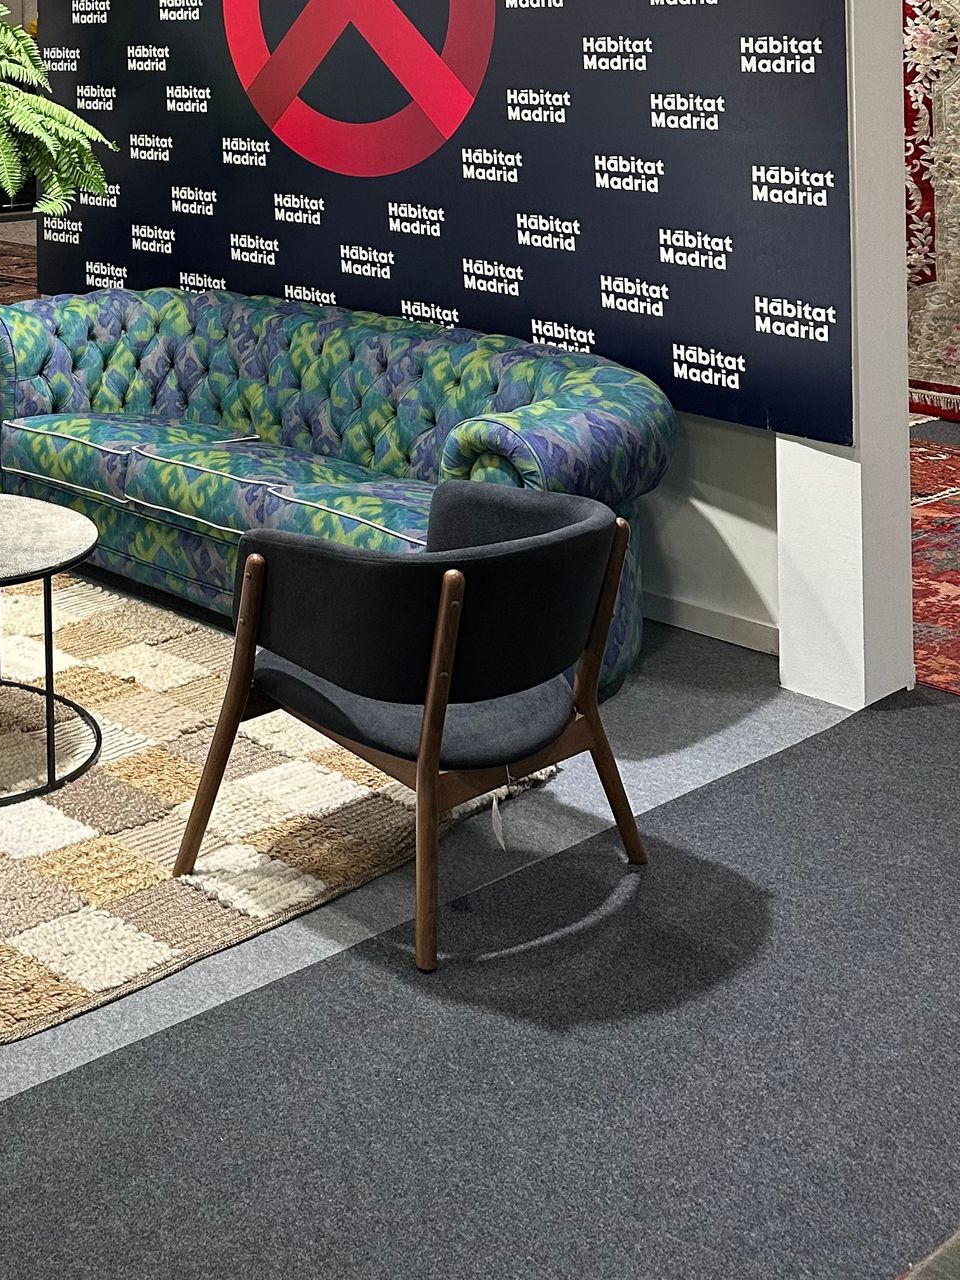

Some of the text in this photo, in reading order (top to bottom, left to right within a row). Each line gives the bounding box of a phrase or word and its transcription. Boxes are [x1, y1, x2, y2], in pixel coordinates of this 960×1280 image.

[72, 11, 107, 23] Madrid
[160, 7, 199, 20] Madrid
[128, 58, 166, 71] Madrid
[584, 54, 646, 71] Madrid
[741, 55, 815, 73] Madrid
[77, 98, 112, 110] Madrid
[167, 99, 207, 112] Madrid
[508, 106, 565, 123] Madrid
[651, 112, 718, 130] Madrid
[131, 147, 169, 161] Madrid
[223, 152, 266, 166] Madrid
[463, 164, 517, 182] Madrid
[596, 173, 658, 192] Madrid
[79, 192, 118, 208] Madrid
[752, 184, 827, 206] Madrid
[172, 200, 213, 215] Madrid
[275, 208, 320, 225] Madrid
[389, 218, 440, 236] Madrid
[44, 229, 79, 244] Madrid
[518, 230, 575, 251] Madrid
[132, 238, 171, 253] Madrid
[231, 248, 275, 265] Madrid
[660, 247, 726, 270] Madrid
[341, 260, 390, 279] Madrid
[86, 274, 124, 289] Madrid
[464, 274, 519, 296] Madrid
[601, 292, 663, 316] Madrid
[755, 315, 828, 342] Madrid
[674, 362, 739, 389] Madrid
